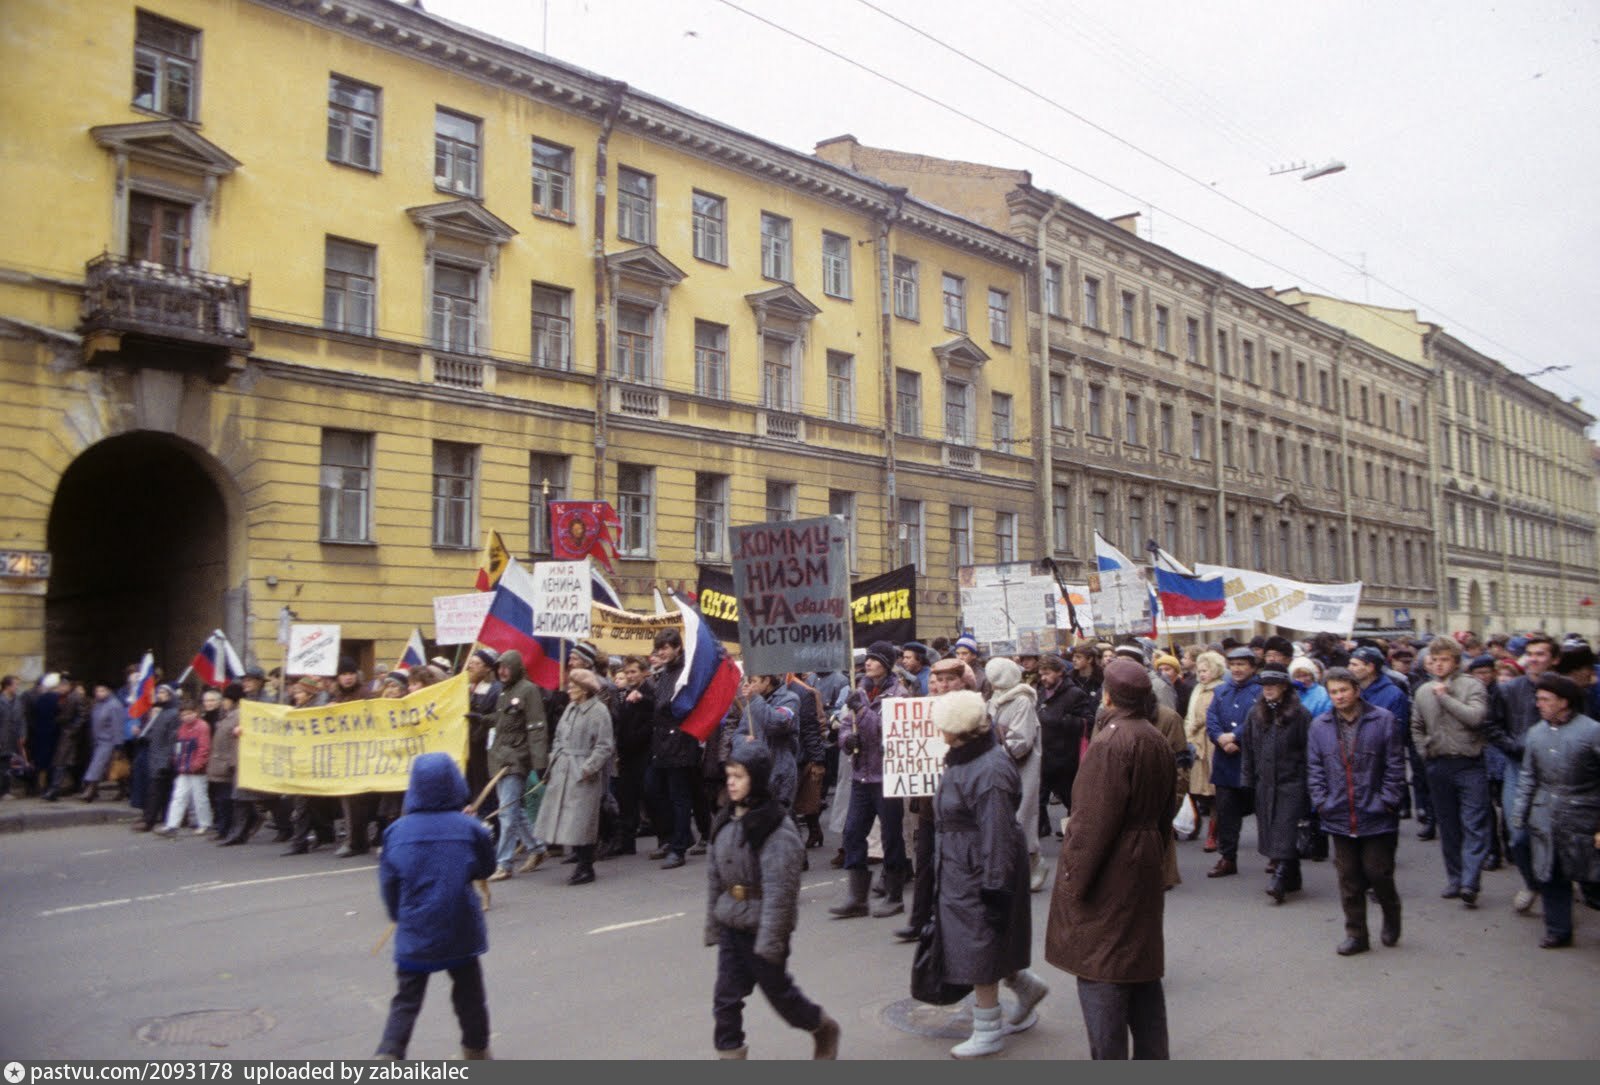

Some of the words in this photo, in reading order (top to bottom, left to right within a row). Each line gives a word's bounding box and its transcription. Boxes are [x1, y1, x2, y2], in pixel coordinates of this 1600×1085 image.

[549, 565, 575, 575] ИМЯ
[746, 556, 829, 593] НИЗМ
[541, 577, 582, 592] ЛЕНИНА
[546, 594, 578, 610] ИМЯ
[741, 593, 796, 627] НА
[535, 612, 589, 632] АНТИХРИСТА
[886, 739, 929, 759] ВСЕХ
